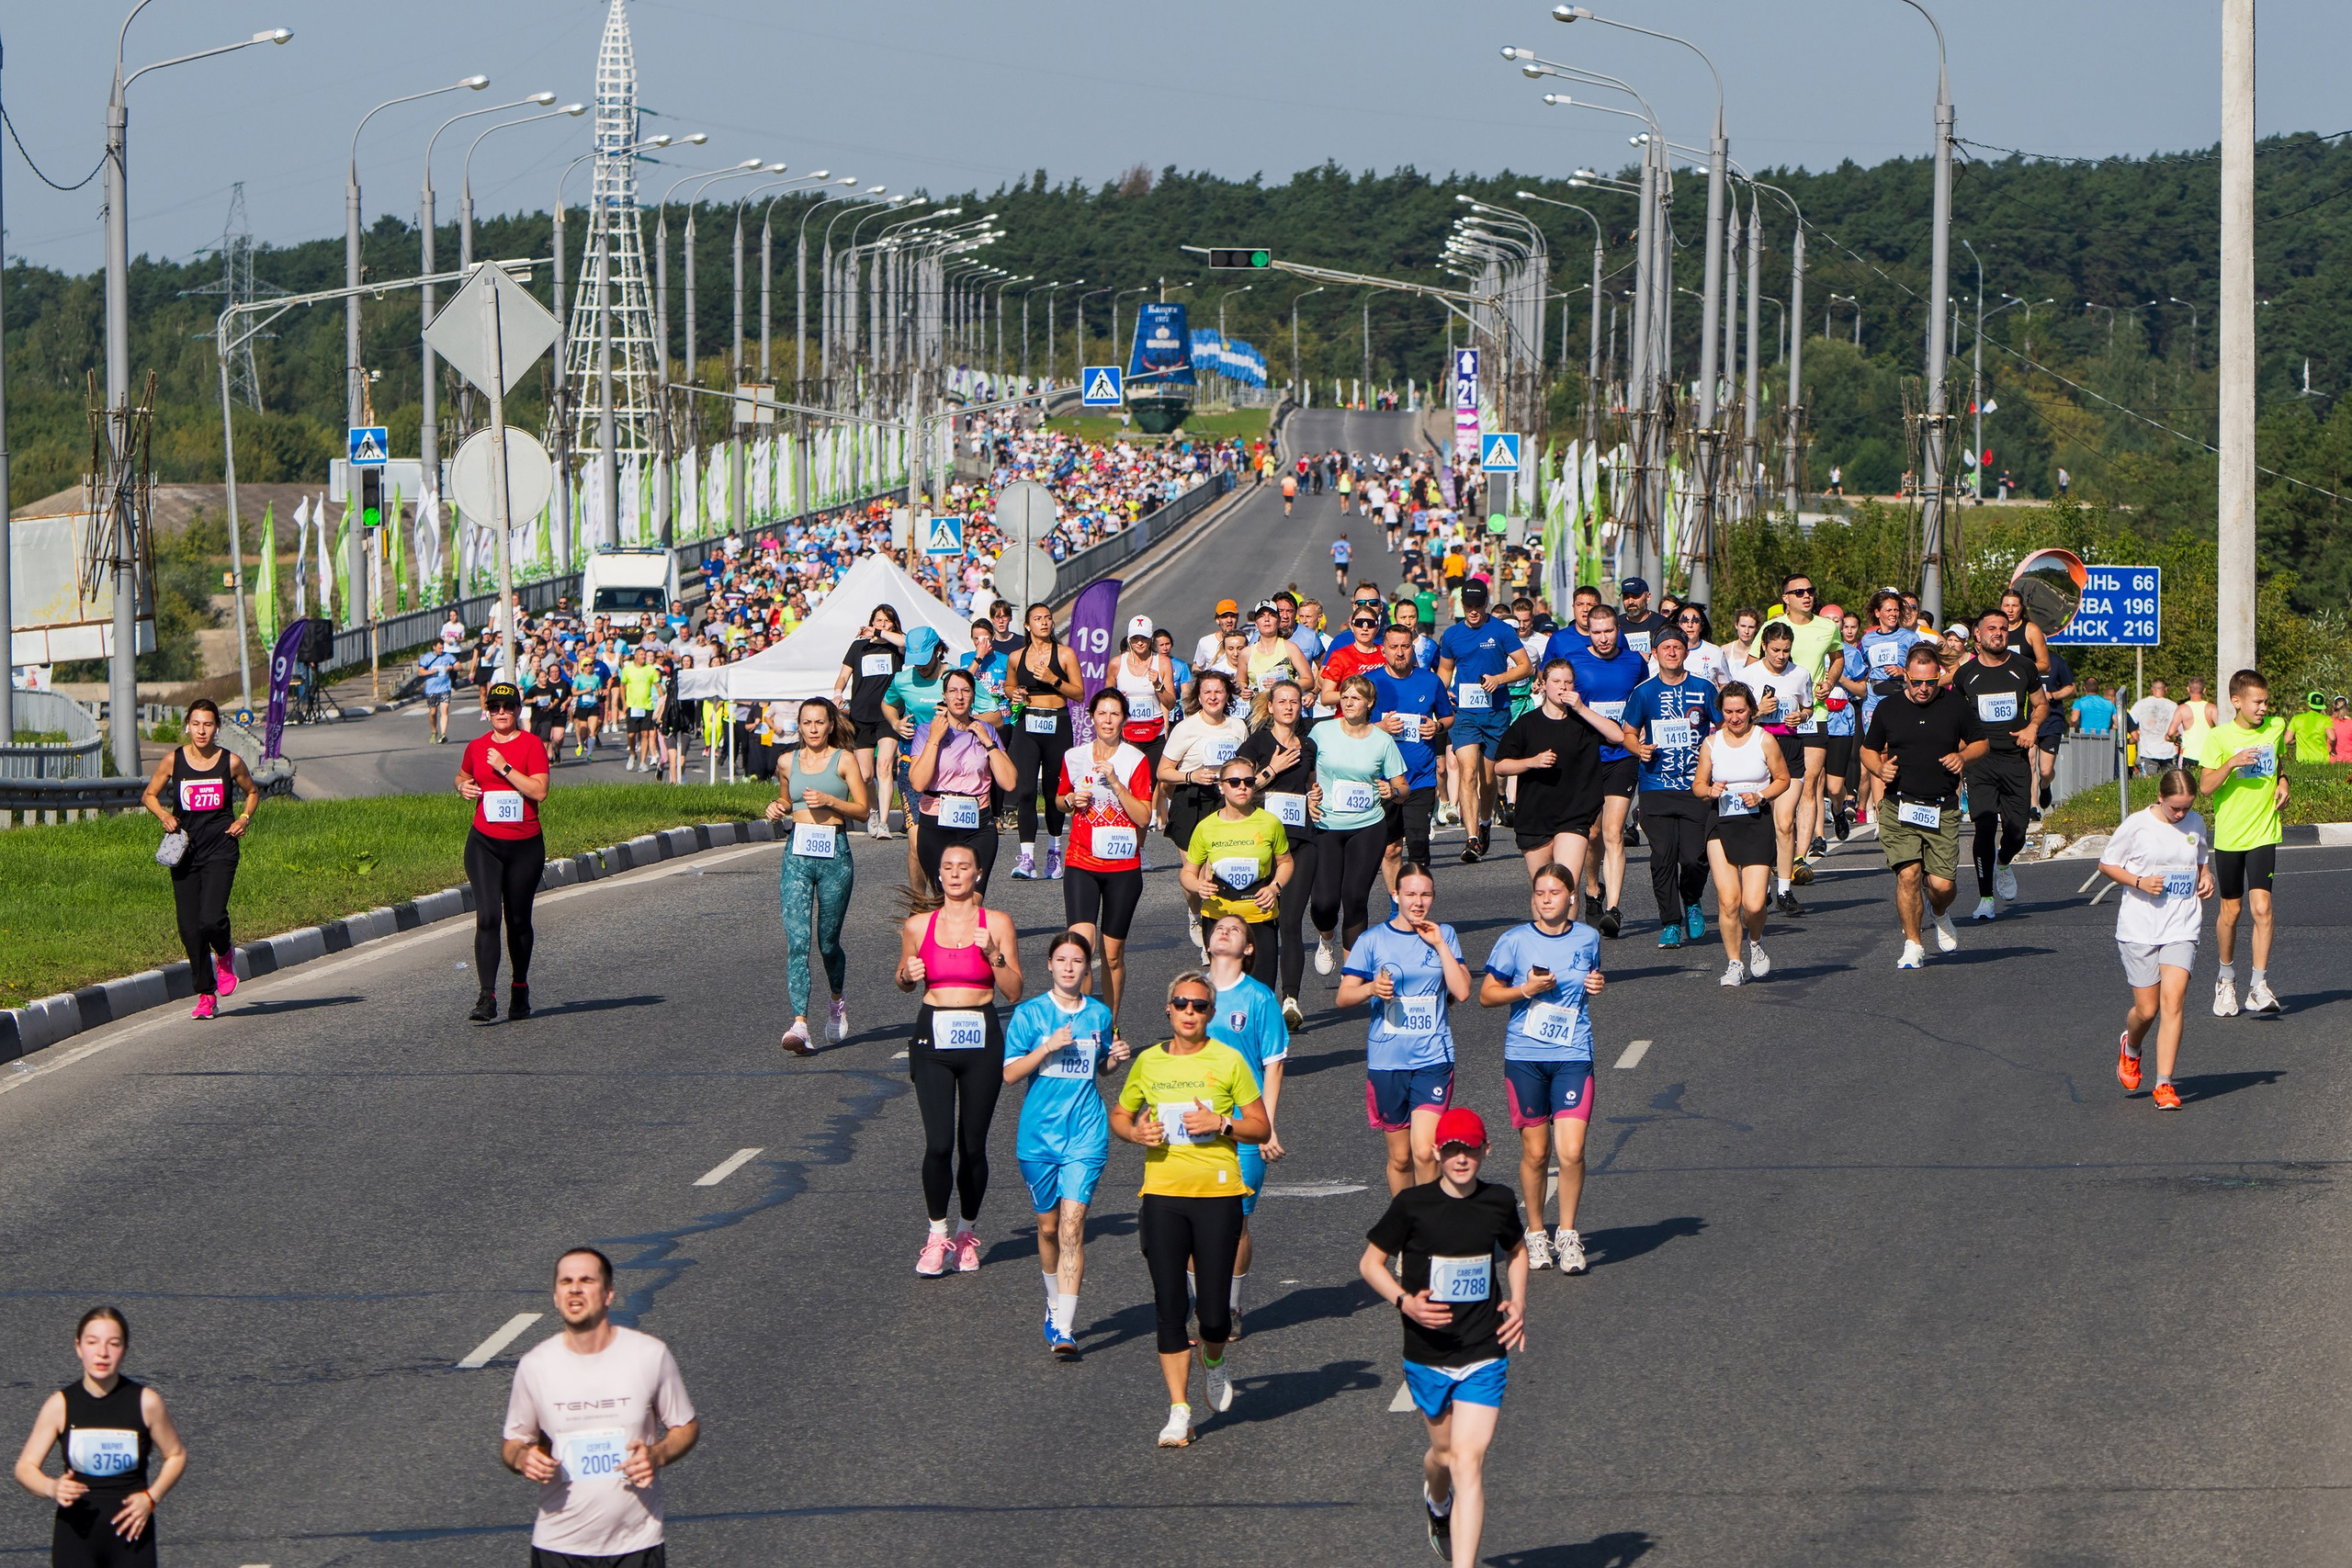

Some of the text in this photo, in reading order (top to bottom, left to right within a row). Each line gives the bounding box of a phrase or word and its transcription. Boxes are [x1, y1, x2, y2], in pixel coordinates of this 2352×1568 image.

[1457, 378, 1477, 405] 21
[2132, 574, 2154, 591] 66
[2122, 597, 2154, 615] 196
[2122, 620, 2154, 637] 216
[1076, 626, 1109, 654] 19
[1469, 695, 1489, 705] 2473
[1131, 707, 1151, 718] 4340
[1994, 705, 2011, 717] 863
[1035, 719, 1054, 730] 1406
[1663, 725, 1687, 733] АЛЕКСАНДР
[1665, 731, 1688, 745] 1419
[198, 786, 215, 795] МАРИЯ
[195, 793, 220, 807] 2776
[1346, 796, 1371, 809] 4322
[498, 806, 517, 818] 391
[952, 811, 977, 825] 3460
[1283, 808, 1300, 821] 350
[1912, 811, 1936, 825] 3052
[806, 839, 831, 853] 3988
[1106, 841, 1133, 855] 2747
[1211, 839, 1255, 849] AstraZeneca
[1227, 873, 1255, 886] 3897
[2165, 881, 2191, 895] 4023
[951, 1021, 978, 1029] ВИКТОРИЯ
[1402, 1014, 1432, 1031] 4936
[1547, 1013, 1567, 1023] ПОЛИНА
[950, 1029, 980, 1045] 2840
[1539, 1021, 1569, 1041] 3374
[1060, 1058, 1090, 1074] 1028
[1151, 1079, 1204, 1091] AstraZeneca
[1456, 1267, 1484, 1278] САВЕЛИЙ
[1452, 1276, 1486, 1296] 2788
[553, 1397, 632, 1412] TENET
[586, 1441, 612, 1453] СЕРГЕЙ
[94, 1453, 133, 1471] 3750
[582, 1453, 622, 1475] 2005
